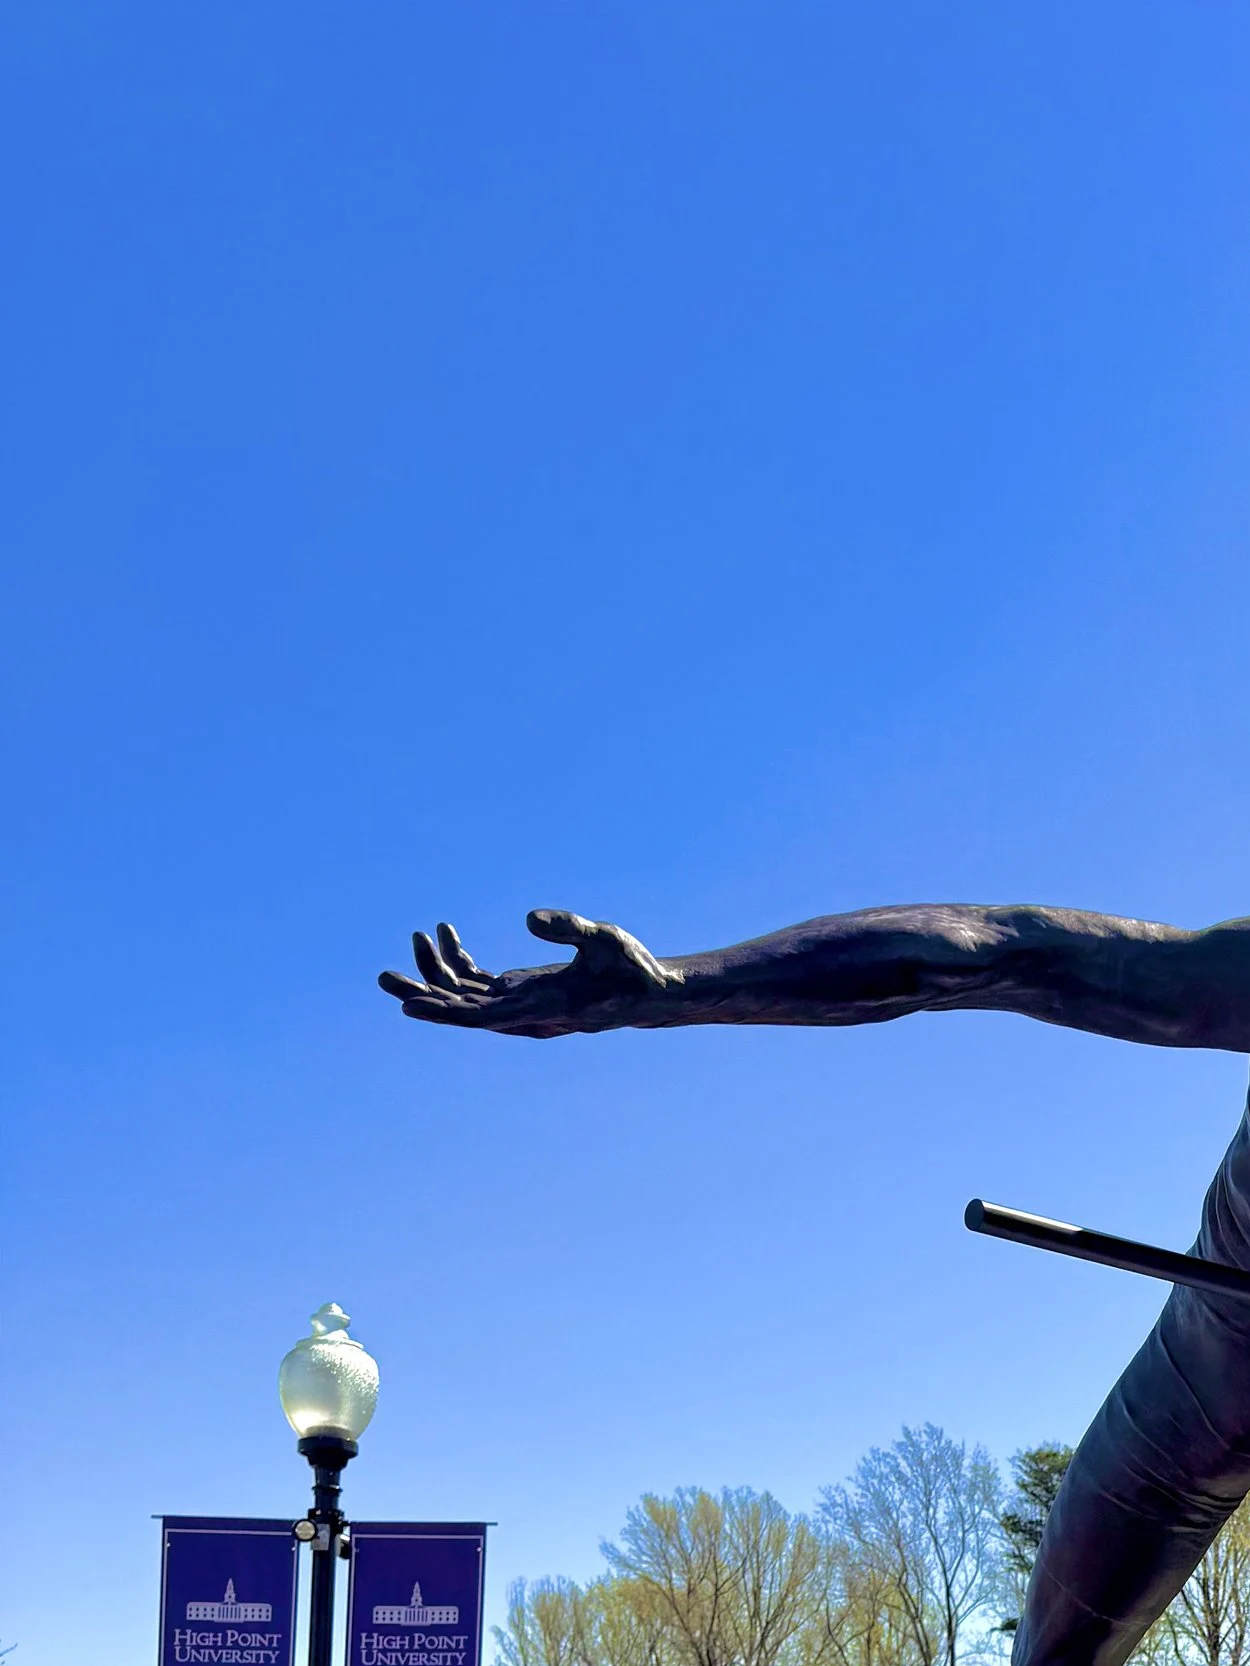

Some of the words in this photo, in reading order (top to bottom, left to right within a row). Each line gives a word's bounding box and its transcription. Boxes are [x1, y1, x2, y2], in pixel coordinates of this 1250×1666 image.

[174, 1629, 222, 1646] HIGH
[226, 1629, 281, 1647] POINT
[360, 1632, 409, 1649] HIGH
[413, 1632, 468, 1649] POINT
[174, 1646, 280, 1664] UNIVERSITY
[361, 1649, 466, 1666] UNIVERSITY
